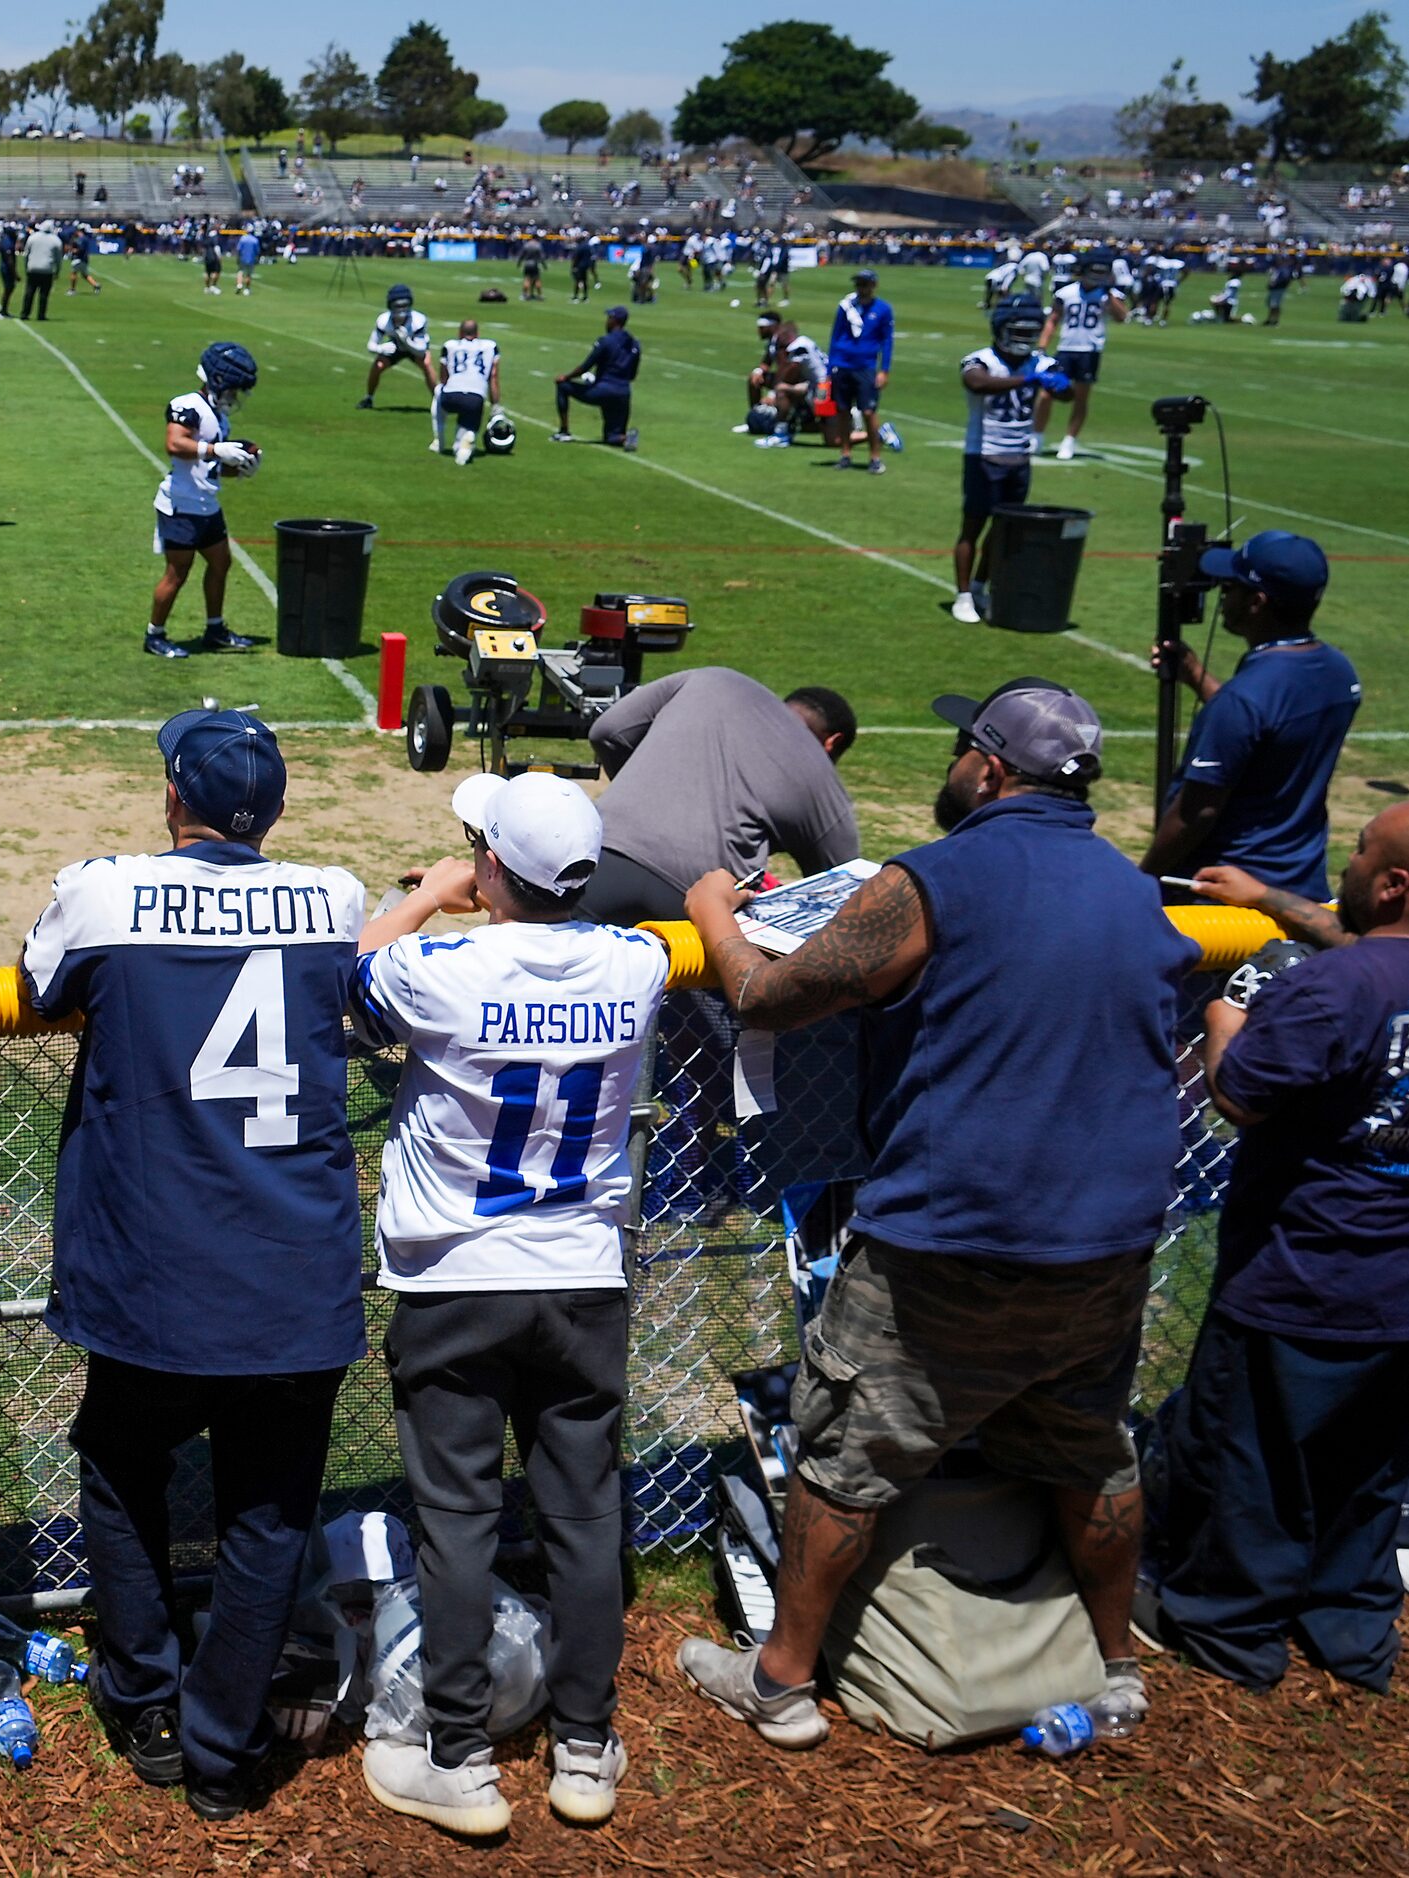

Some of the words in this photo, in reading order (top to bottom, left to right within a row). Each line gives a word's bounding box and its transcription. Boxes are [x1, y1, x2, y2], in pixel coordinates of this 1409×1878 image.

[1067, 302, 1101, 329] 86
[454, 349, 486, 376] 84
[129, 883, 336, 937] PRESCOTT
[189, 948, 300, 1149] 4
[477, 1000, 636, 1045] PARSONS
[472, 1061, 606, 1217] 11
[724, 1552, 776, 1632] NIKE
